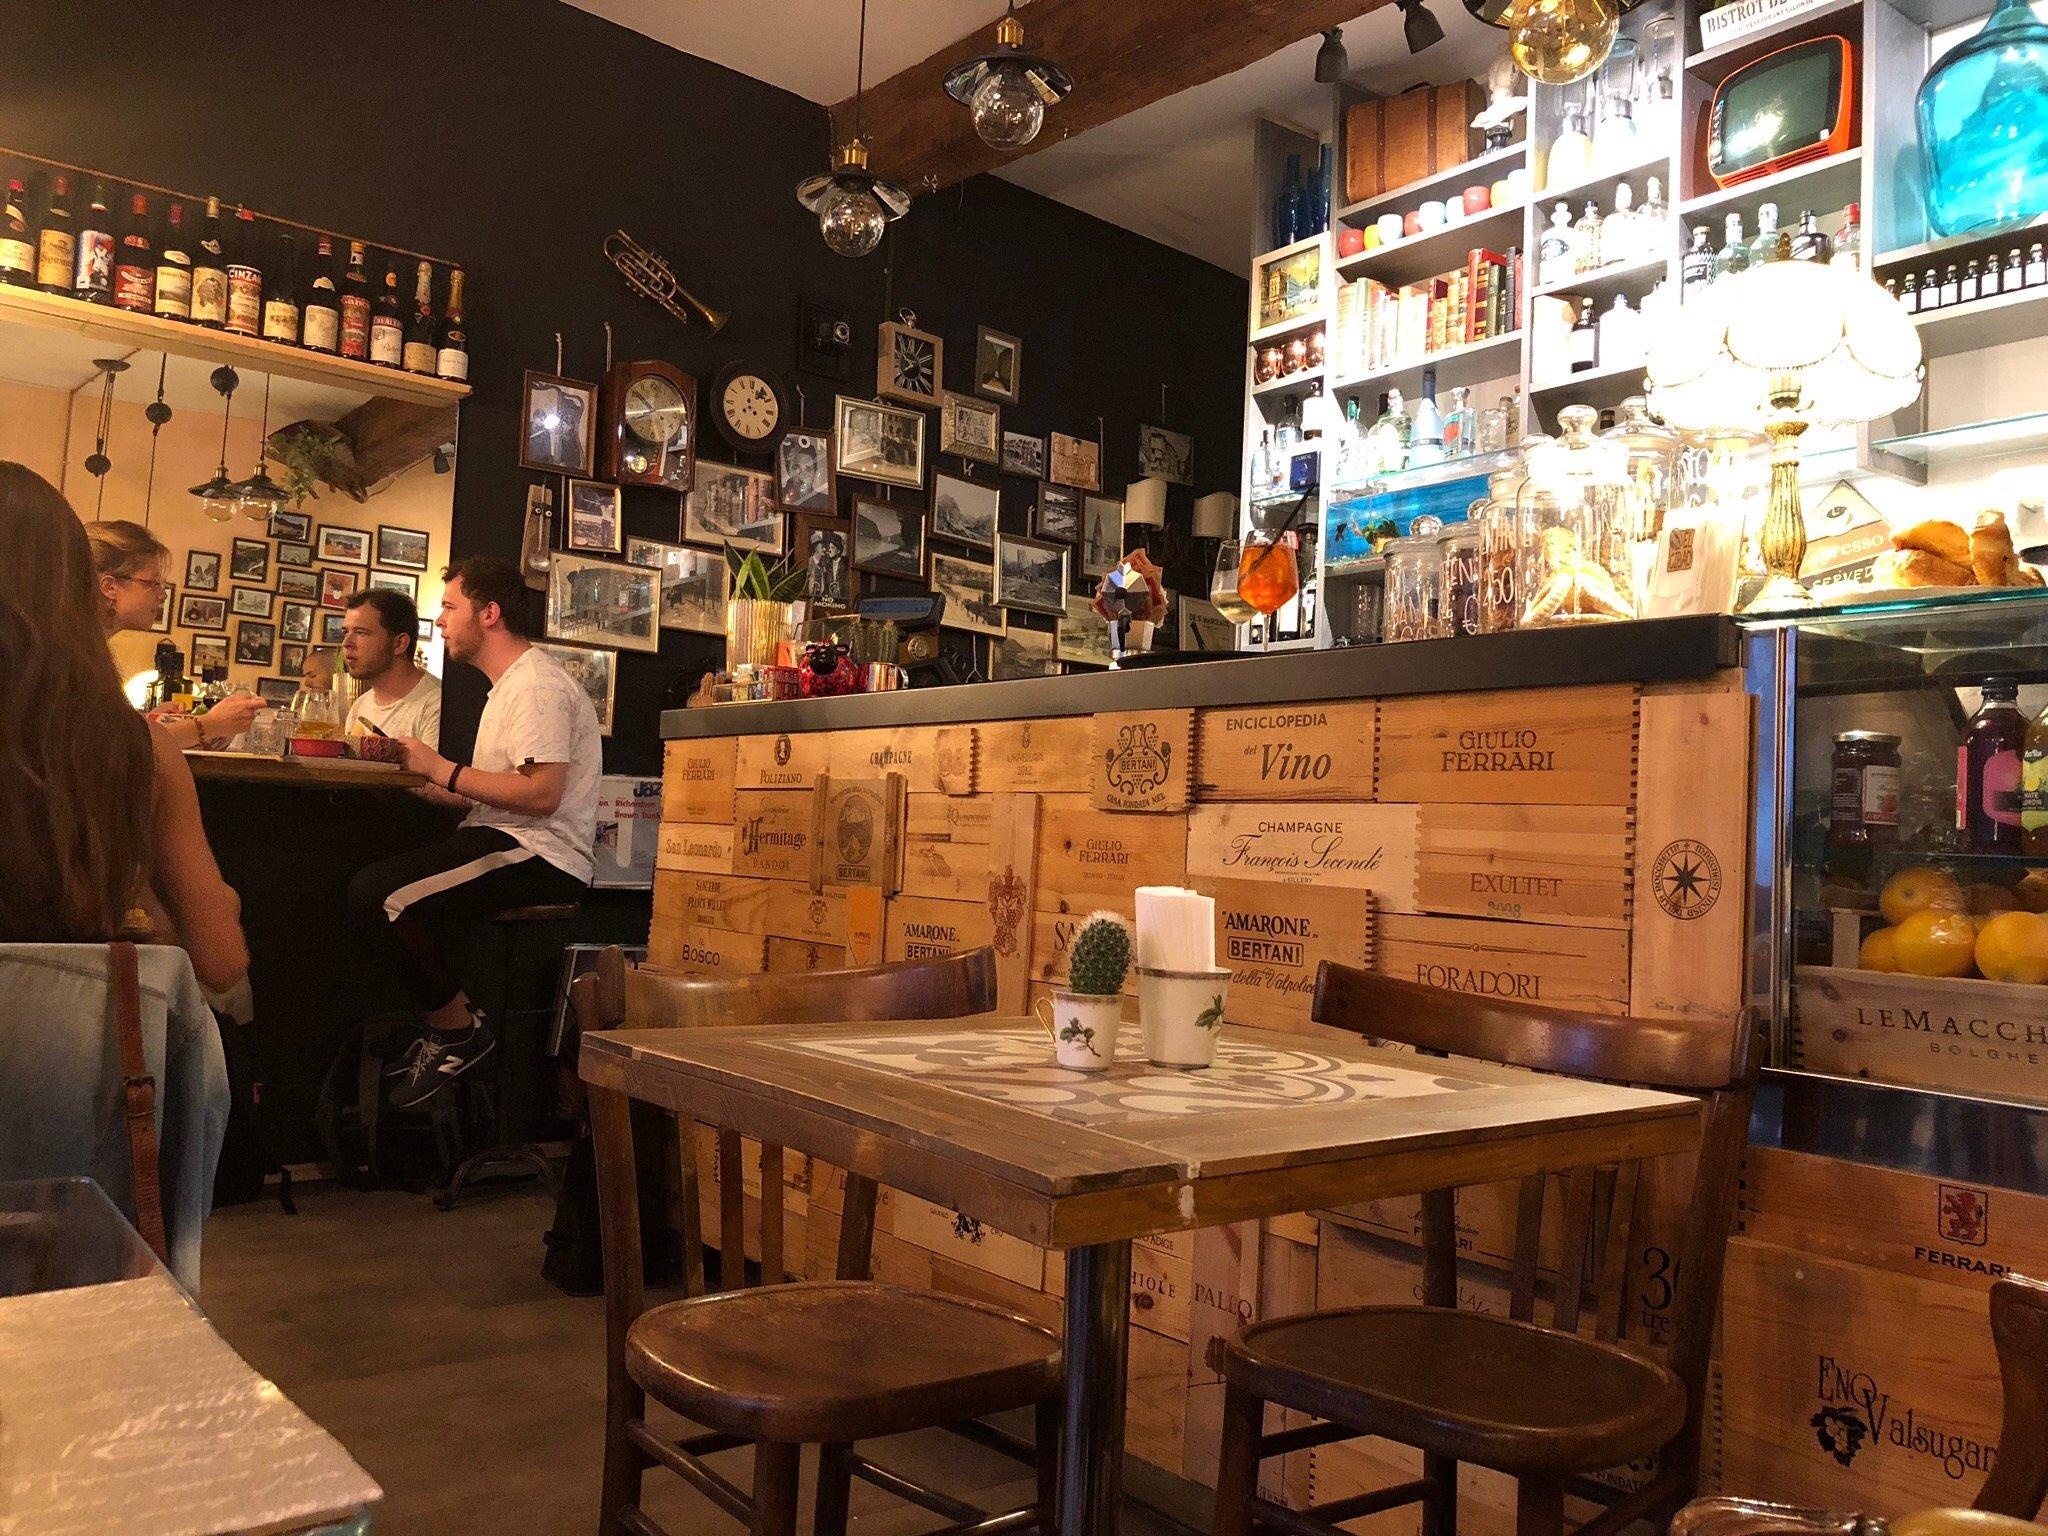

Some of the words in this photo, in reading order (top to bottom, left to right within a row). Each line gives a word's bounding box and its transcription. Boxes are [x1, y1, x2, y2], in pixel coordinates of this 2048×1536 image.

[228, 269, 262, 282] CINZA
[810, 601, 846, 609] MOKING
[1226, 713, 1328, 731] ENCICLOPEDIA
[1459, 730, 1537, 749] GIULIO
[1121, 758, 1156, 771] BERTANI
[1243, 745, 1256, 756] del
[1261, 743, 1332, 780] Vino
[1441, 751, 1555, 772] FERRARI
[759, 770, 802, 784] POLIZIANO
[1258, 822, 1343, 833] CHAMPAGNE
[666, 838, 680, 855] San
[1087, 839, 1122, 851] GIULIO
[1222, 834, 1300, 872] François
[1304, 835, 1383, 871] Secondé
[1079, 851, 1130, 864] FERRARI
[838, 867, 868, 880] BERTANI
[1470, 873, 1562, 897] EXULTET
[682, 944, 720, 966] BOSCO
[1231, 940, 1300, 964] BERTANI
[1233, 969, 1262, 987] della
[1416, 964, 1541, 1000] FORADORI
[1194, 1283, 1253, 1319] PALEO
